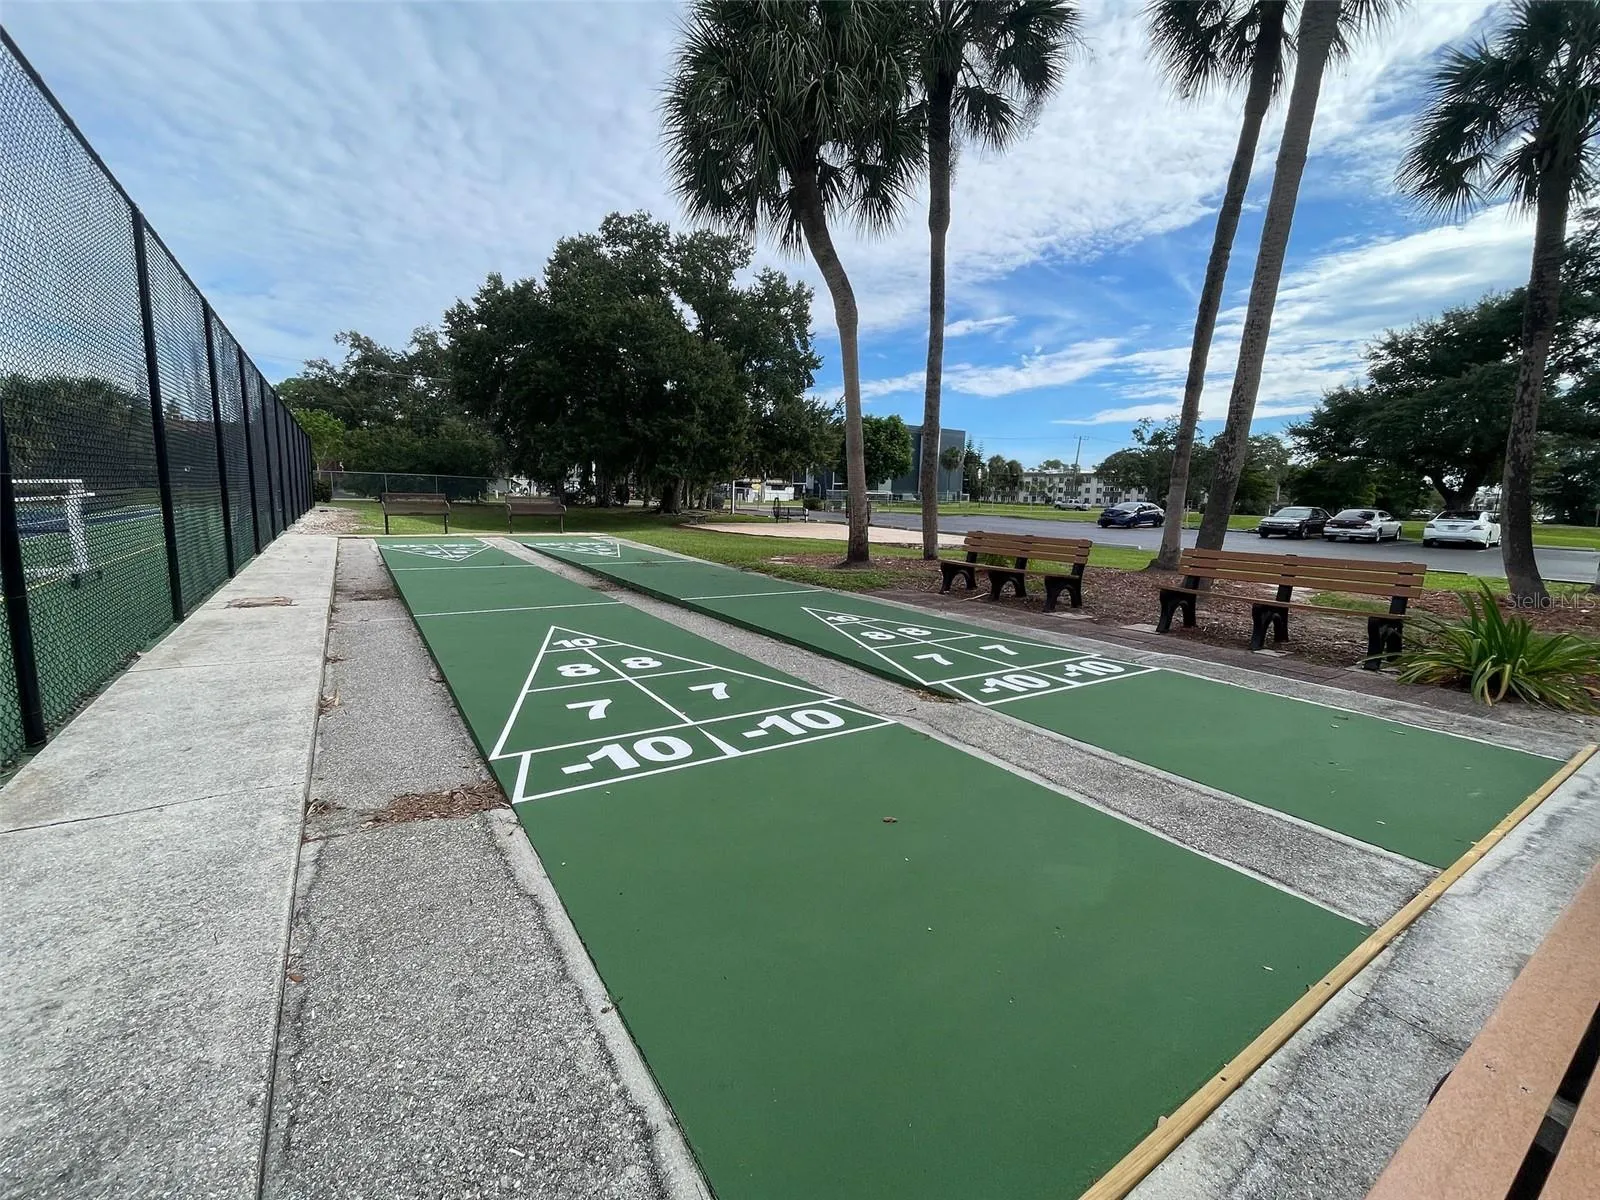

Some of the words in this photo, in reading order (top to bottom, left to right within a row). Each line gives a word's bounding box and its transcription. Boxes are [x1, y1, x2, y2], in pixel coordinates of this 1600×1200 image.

[860, 631, 896, 641] 8
[898, 627, 932, 636] 8
[552, 637, 598, 649] 10
[979, 644, 1019, 656] 7
[620, 656, 663, 669] 8
[913, 653, 954, 666] 7
[556, 663, 601, 678] 8
[1063, 660, 1125, 678] -10
[688, 681, 730, 701] 7
[980, 674, 1051, 694] -10
[565, 698, 613, 721] 7
[742, 709, 846, 739] -10
[560, 735, 694, 775] -10
